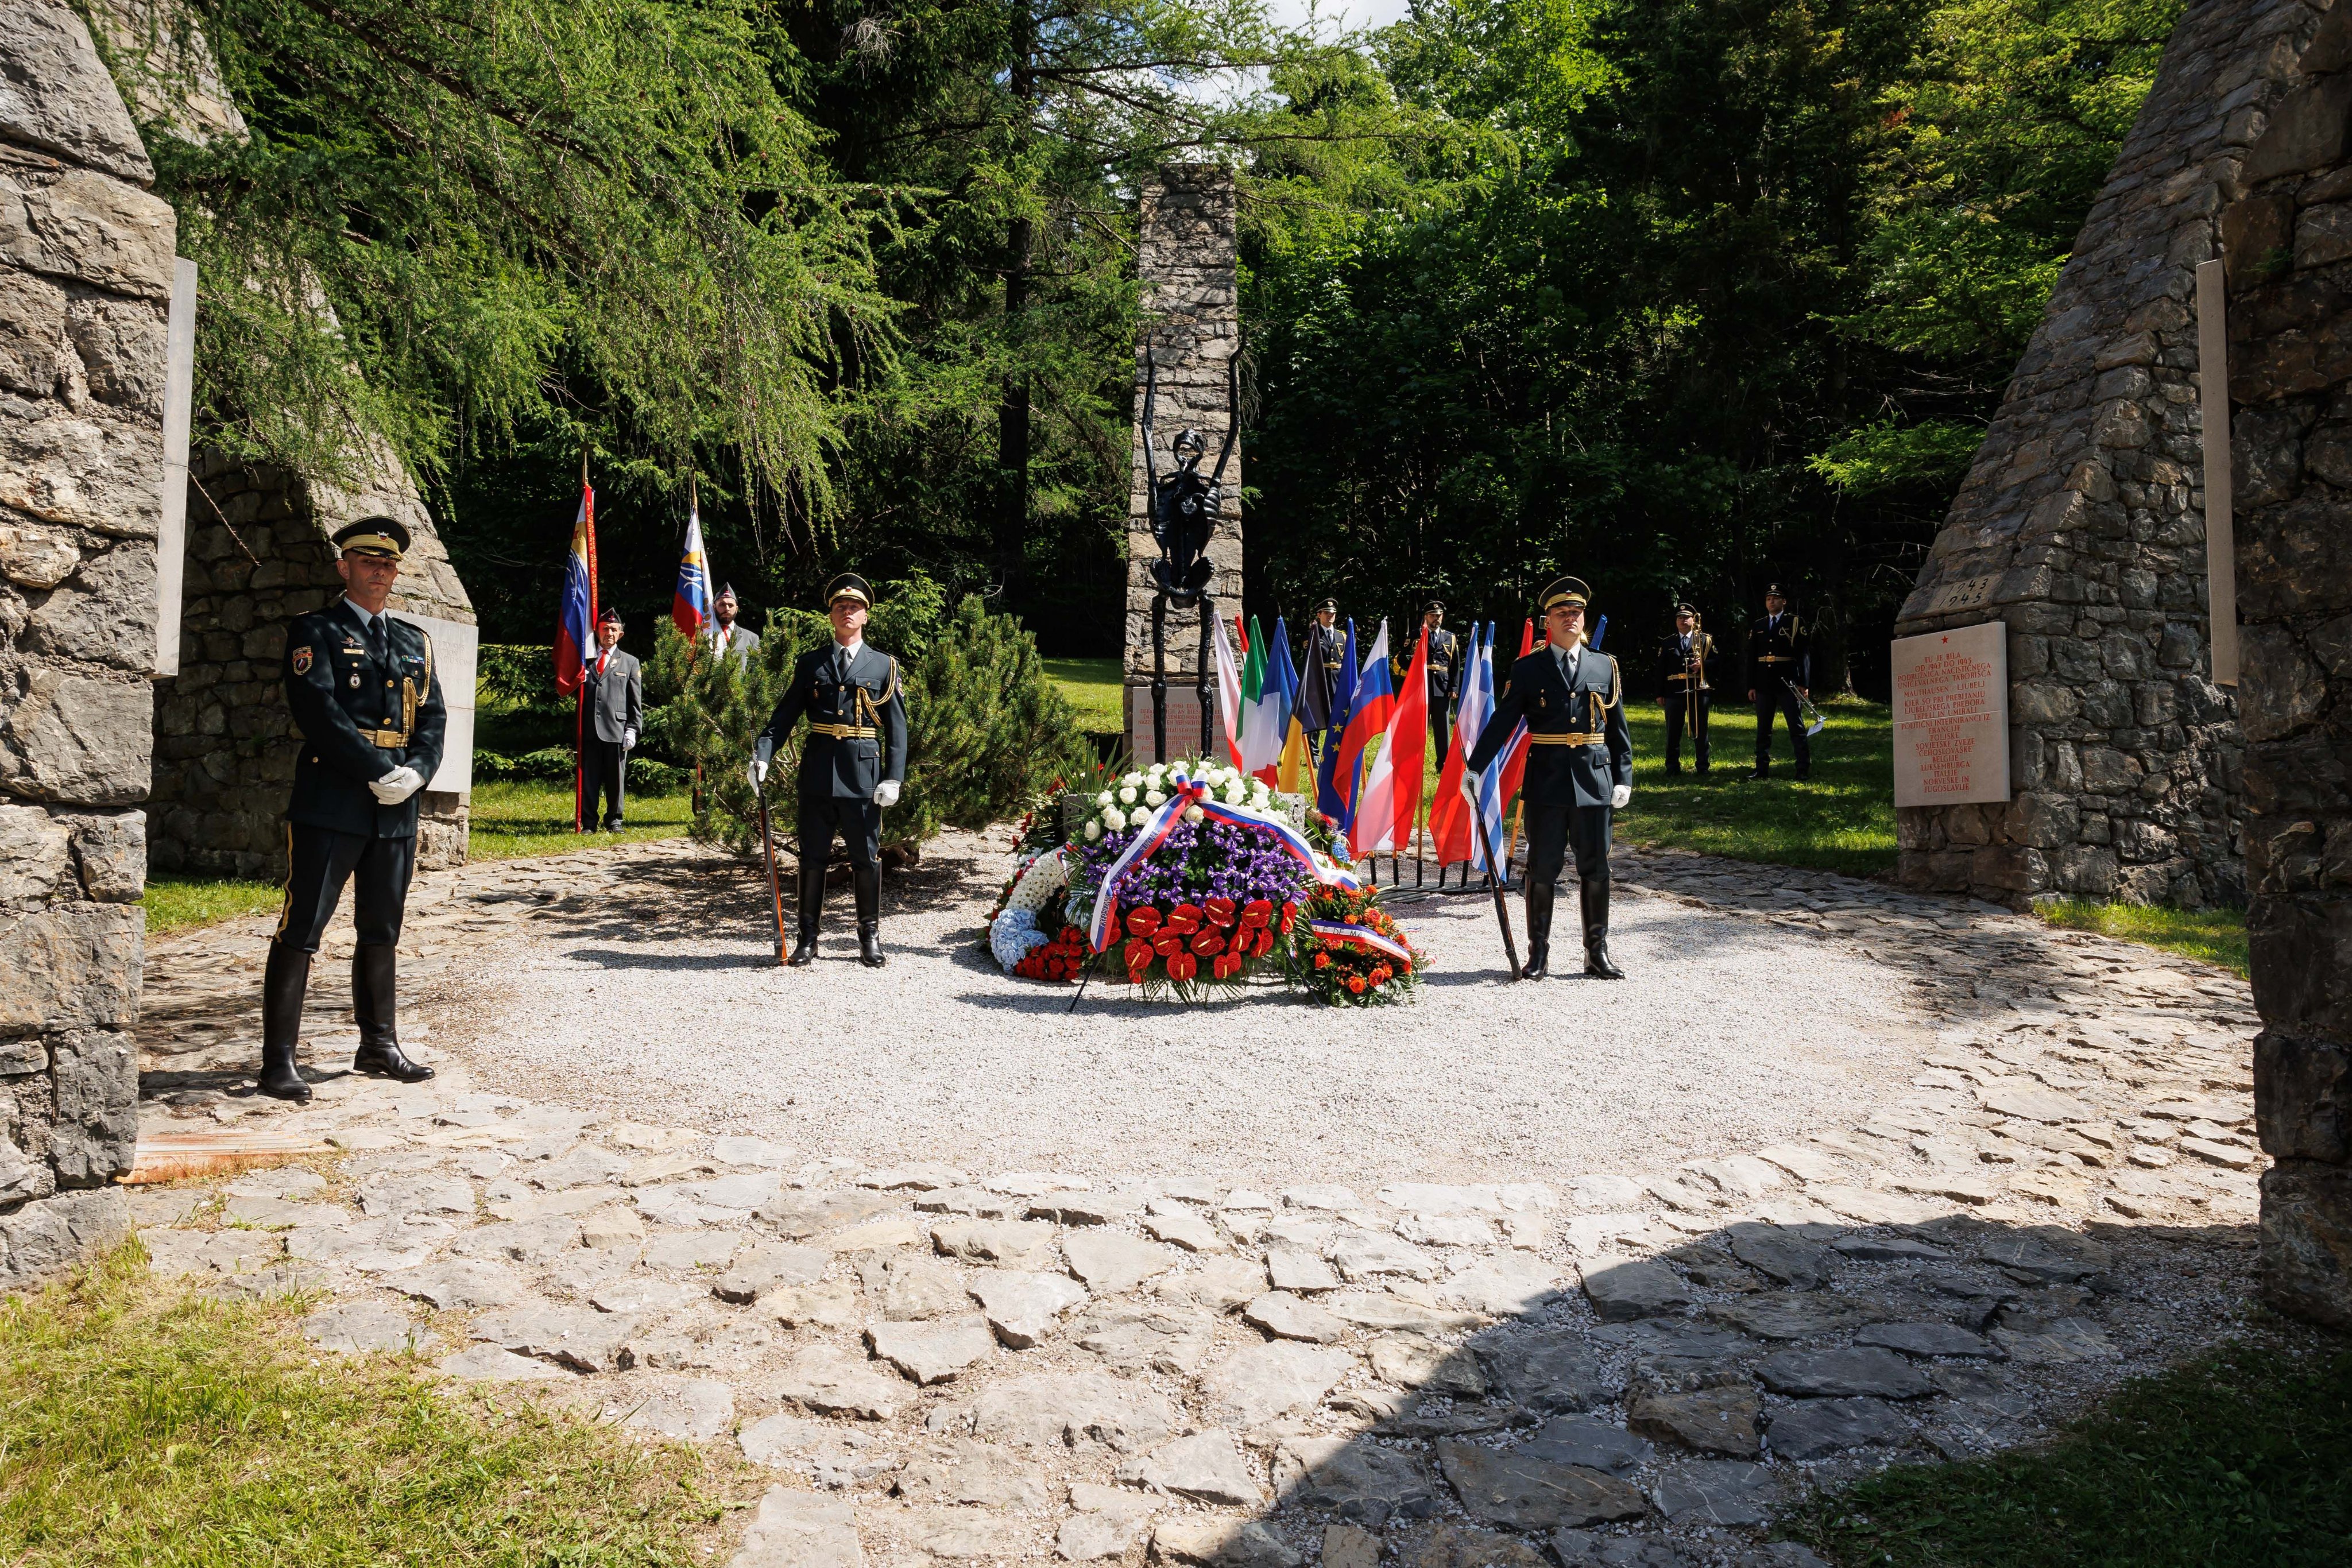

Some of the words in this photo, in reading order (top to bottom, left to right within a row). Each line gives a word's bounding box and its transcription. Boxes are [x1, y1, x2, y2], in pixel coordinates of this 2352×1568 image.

[1946, 578, 1989, 596] 1943
[1938, 592, 1982, 608] 1945
[1928, 662, 1941, 671] 1943
[1958, 657, 1971, 665] 1945
[1952, 669, 1991, 682] TABORIŠČA
[1904, 686, 1949, 698] MAUTHAUSEN
[1957, 680, 1985, 690] LJUBELJ
[1905, 699, 1919, 707] KJER
[1946, 690, 1985, 702] PREBIJANJU
[1905, 703, 1950, 714] LJUBELJSKEGA
[1953, 698, 1985, 708] PREDORA
[1913, 711, 1935, 720] TRPELI
[1948, 707, 1977, 717] UMIRALI
[1901, 721, 1932, 730] POLITIČNI
[1935, 715, 1981, 726] INTERNIRANCI
[1928, 725, 1961, 734] FRANCIJE
[1930, 733, 1959, 741] POLJSKE
[1916, 741, 1951, 750] SOVJETSKE
[1954, 738, 1976, 746] ZVEZE
[1932, 754, 1959, 763] BELGIJE
[1921, 761, 1971, 771] LUKSEMBURGA
[1934, 769, 1958, 777] ITALIJE
[1924, 784, 1970, 793] JUGOSLAVIJE
[1098, 893, 1113, 927] PREDSEDNIK
[1139, 828, 1161, 853] SLOVENIJE
